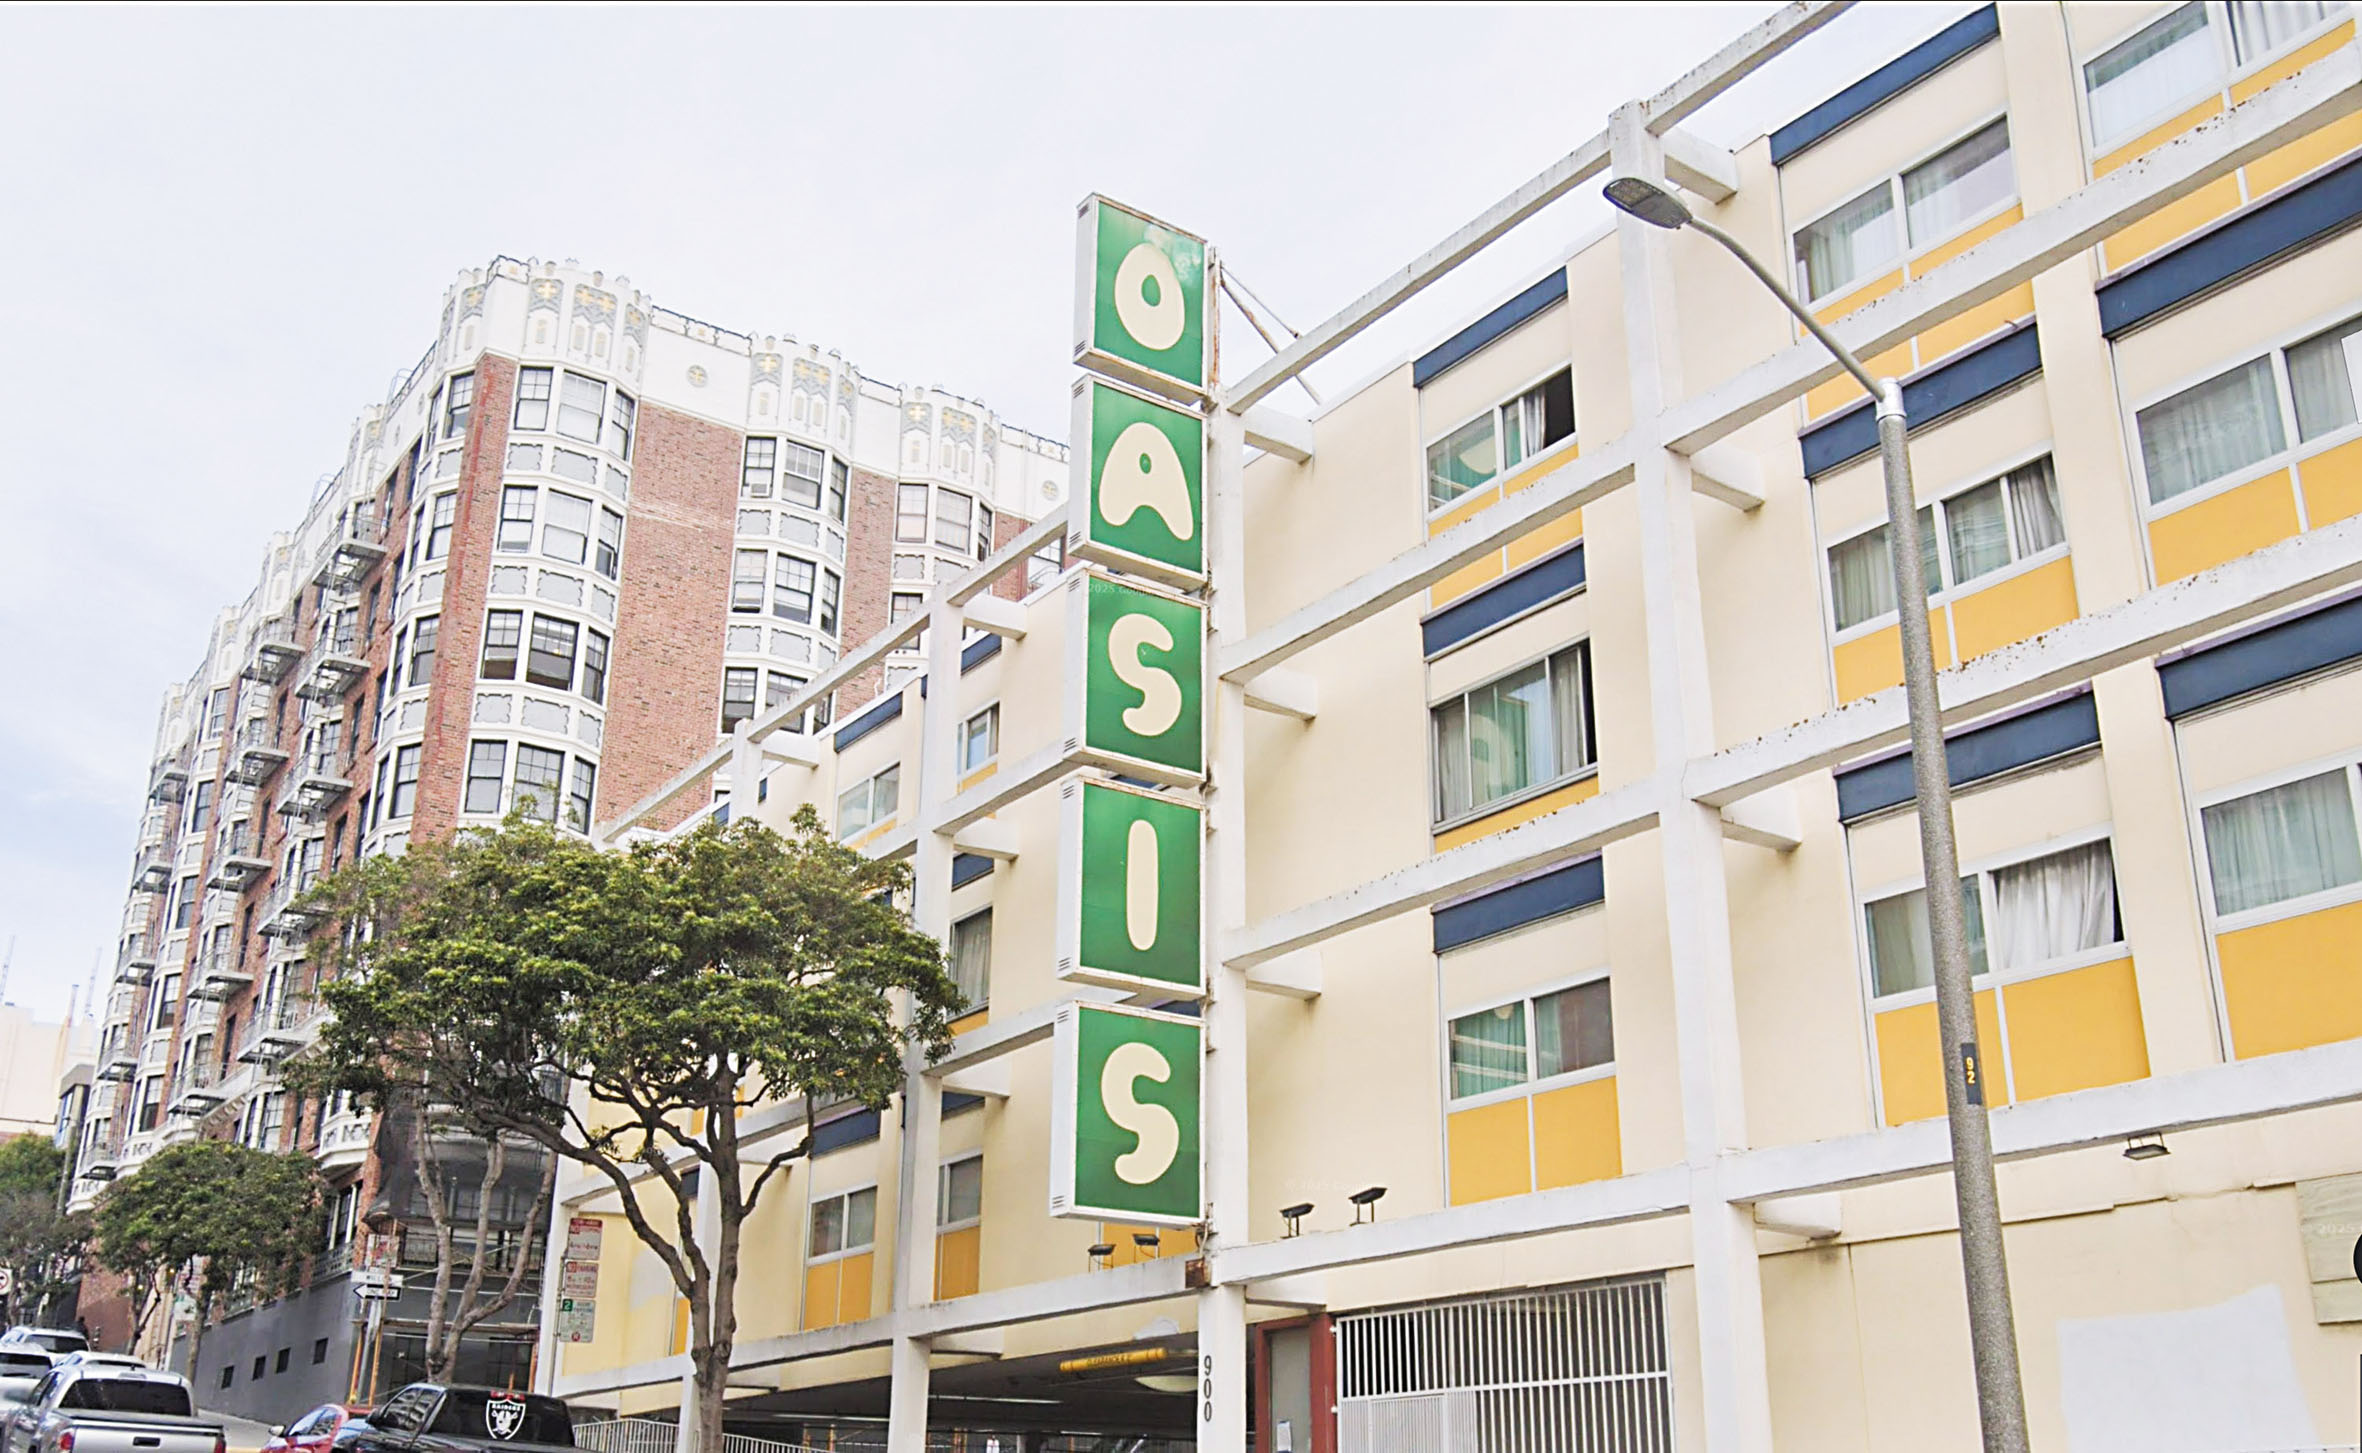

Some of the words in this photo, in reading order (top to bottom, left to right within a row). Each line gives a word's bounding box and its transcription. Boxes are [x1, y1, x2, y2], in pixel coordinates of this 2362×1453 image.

[1098, 242, 1194, 1185] OASIS
[1966, 1057, 1976, 1084] 92
[1203, 1354, 1212, 1423] 900
